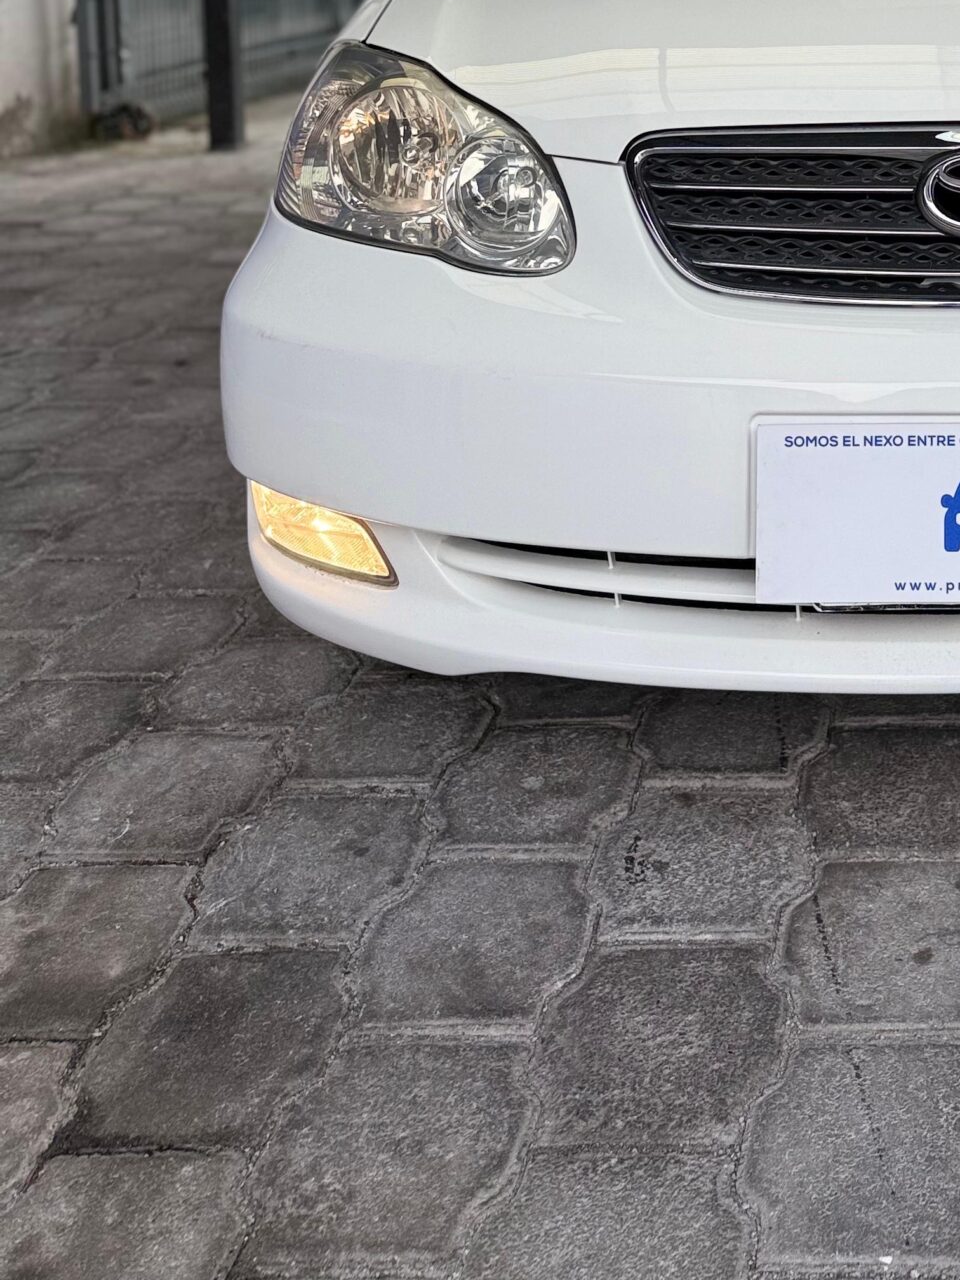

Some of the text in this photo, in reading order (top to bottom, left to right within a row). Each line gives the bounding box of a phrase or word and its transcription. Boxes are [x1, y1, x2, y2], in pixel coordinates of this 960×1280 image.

[784, 435, 839, 448] SOMOS
[842, 435, 861, 447] EL
[863, 435, 904, 447] NEXO
[907, 435, 956, 447] ENTRE
